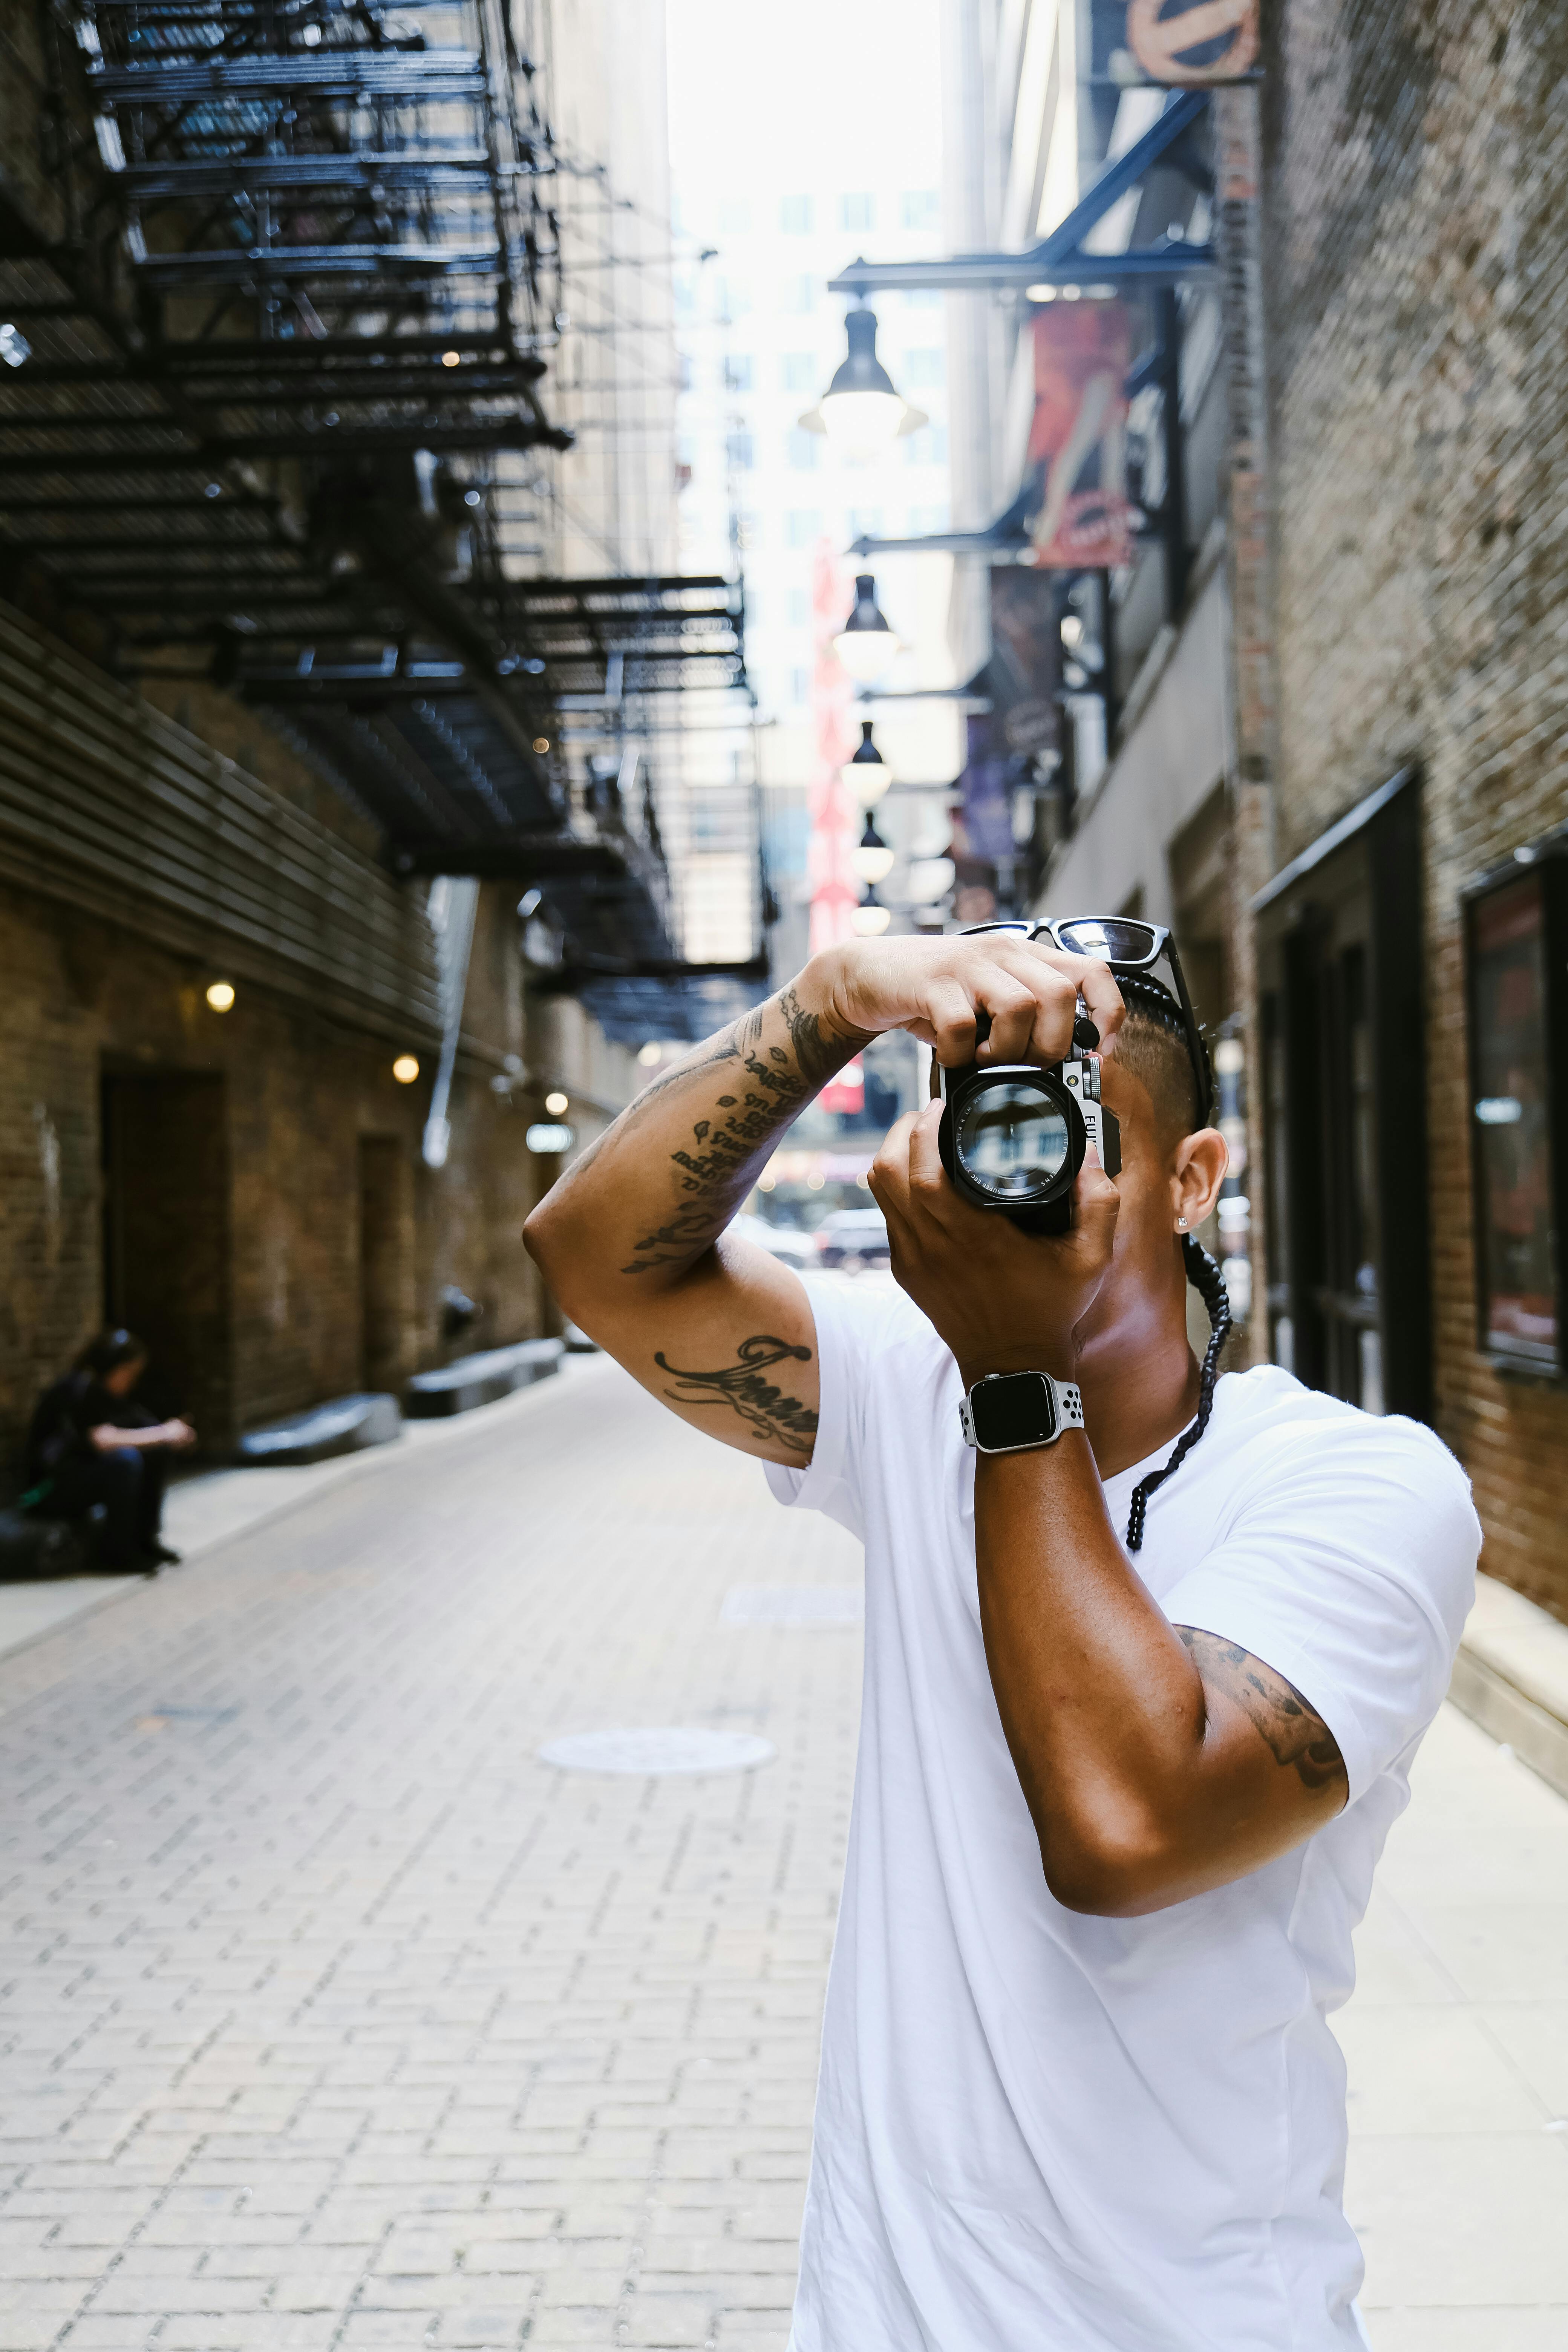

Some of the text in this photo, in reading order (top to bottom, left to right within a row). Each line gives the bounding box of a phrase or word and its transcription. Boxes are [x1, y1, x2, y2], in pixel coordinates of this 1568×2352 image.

[965, 1106, 972, 1115] LM
[1057, 1121, 1068, 1168] ASPHERICAL
[971, 1173, 981, 1184] EBC
[1041, 1171, 1057, 1186] LENS
[982, 1182, 1001, 1194] SUPER
